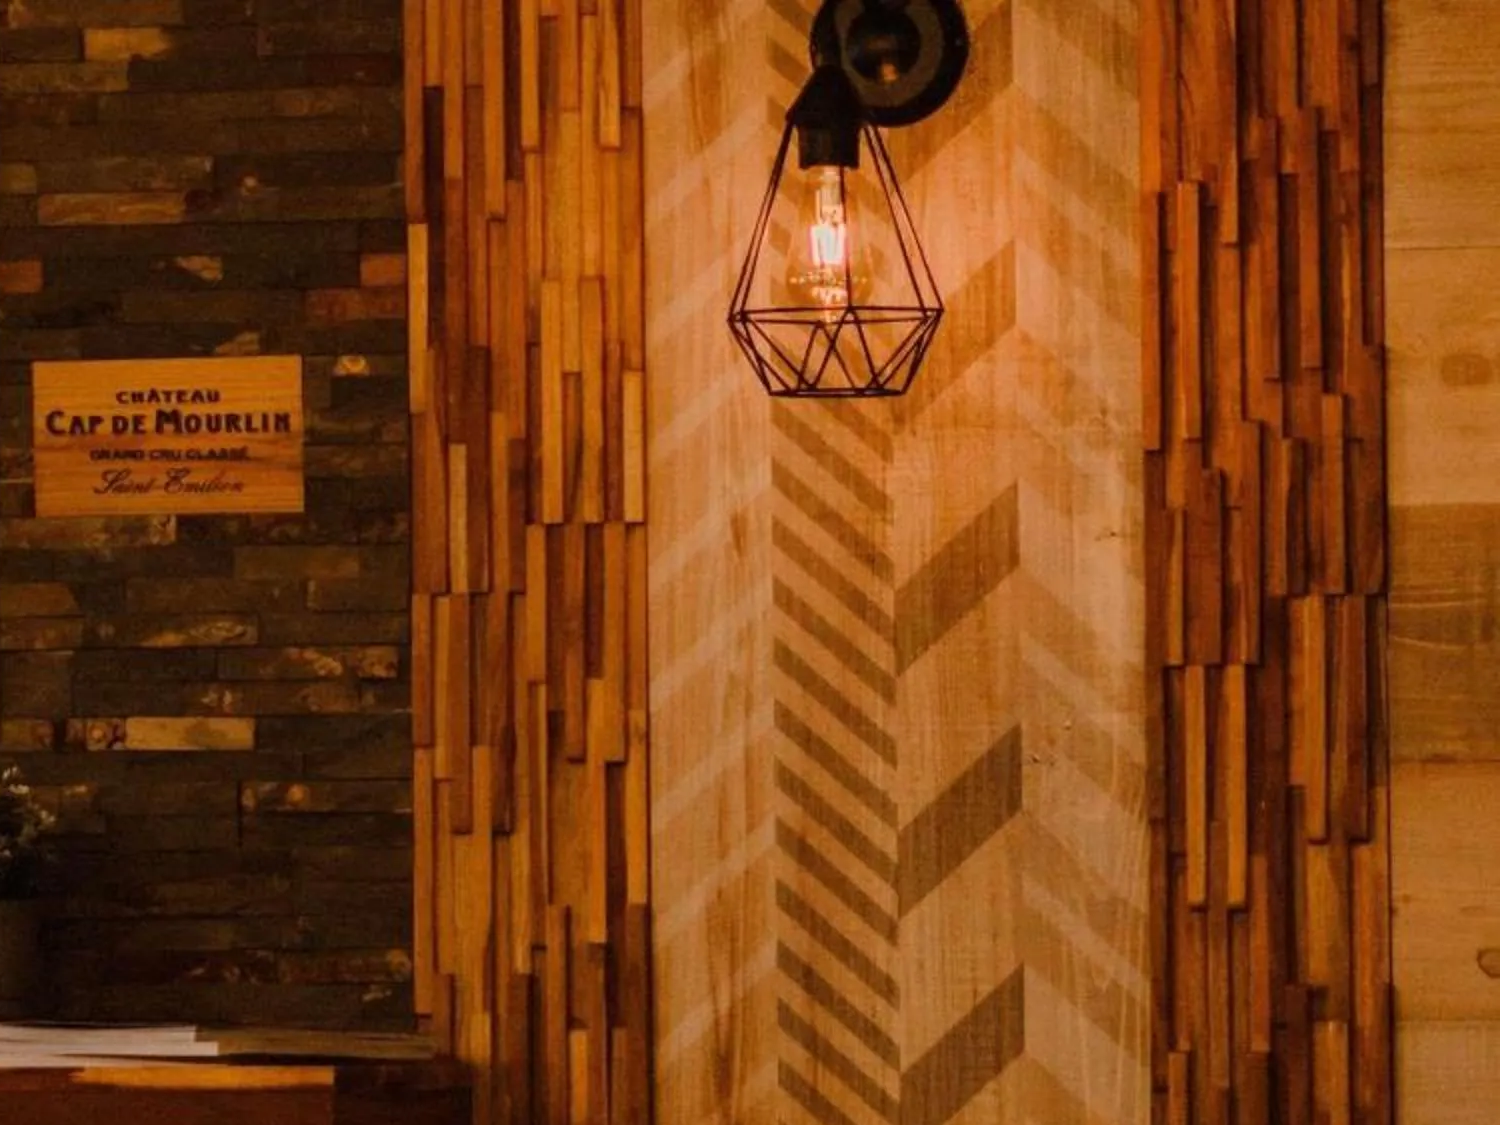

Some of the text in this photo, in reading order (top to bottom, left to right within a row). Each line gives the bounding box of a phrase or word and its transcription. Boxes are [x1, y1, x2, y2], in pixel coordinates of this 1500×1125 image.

[46, 407, 292, 436] CAP DE MOURLIN
